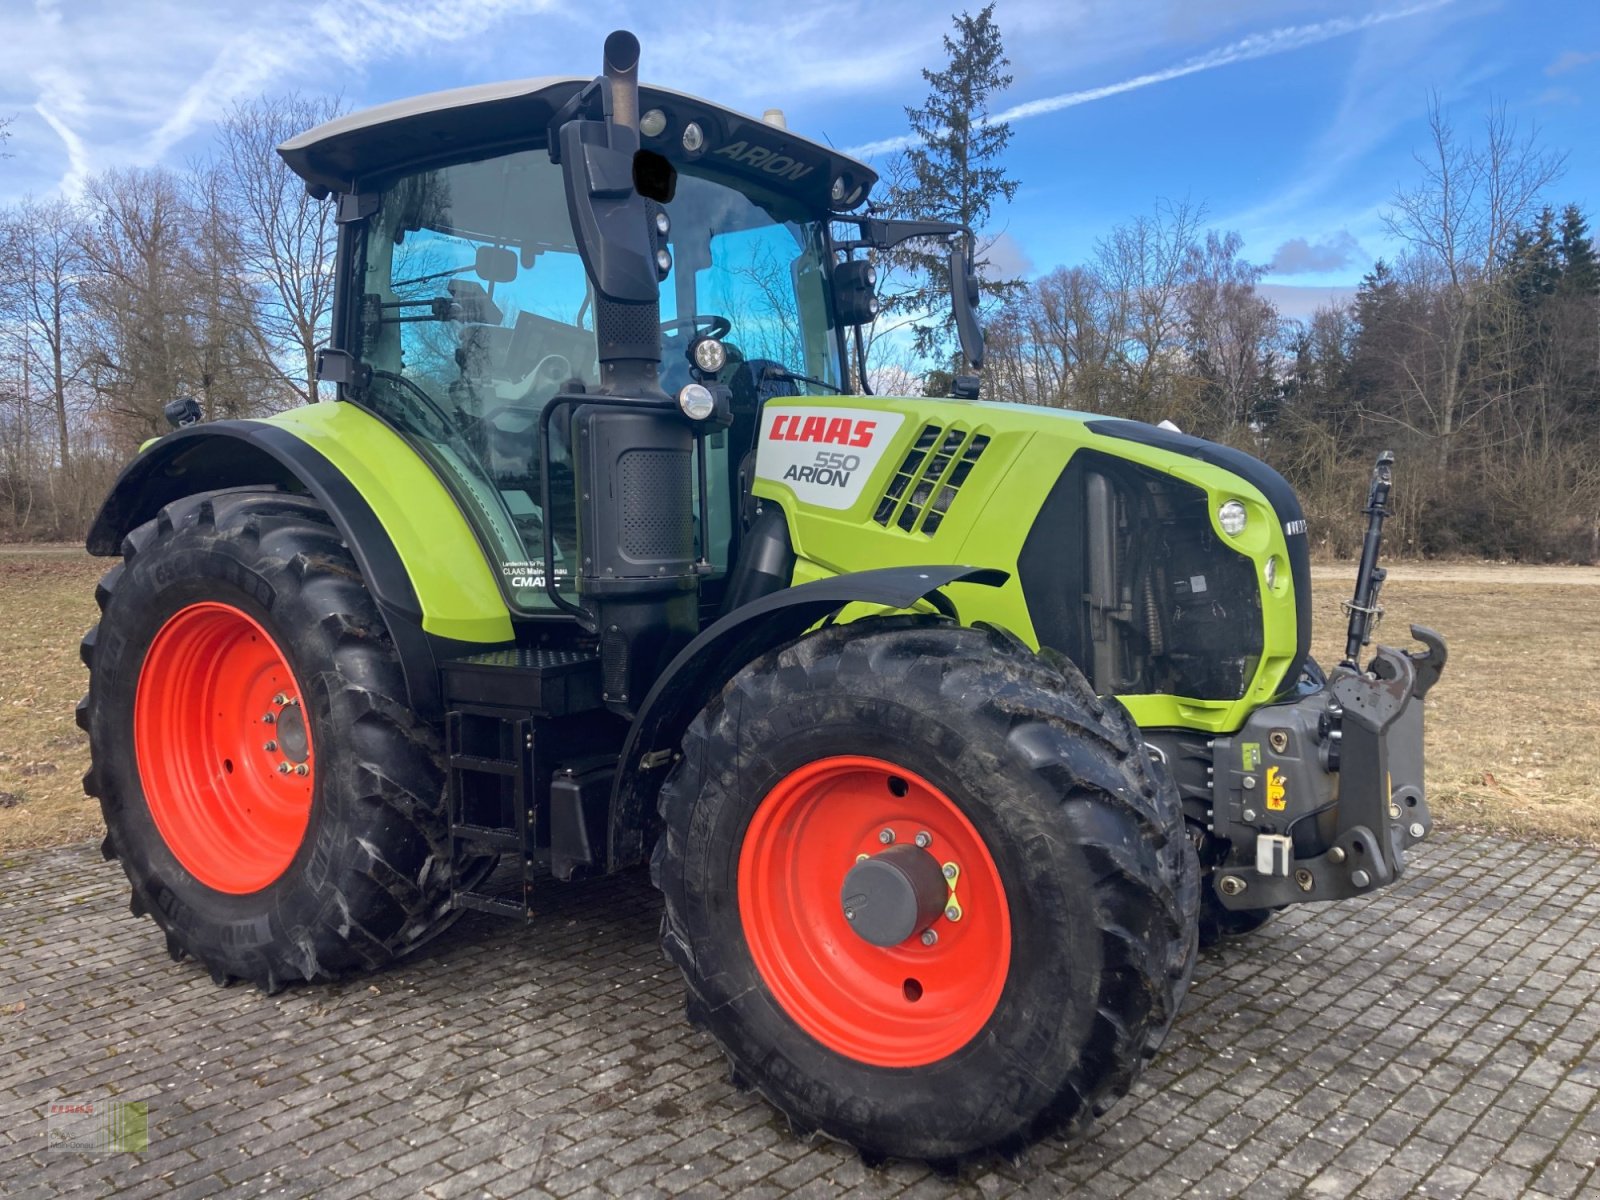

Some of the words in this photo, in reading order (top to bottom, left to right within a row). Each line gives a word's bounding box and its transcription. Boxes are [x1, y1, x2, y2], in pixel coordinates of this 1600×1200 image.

[712, 140, 814, 181] ARION
[769, 415, 877, 448] CLAAS
[813, 451, 861, 471] 550
[783, 464, 850, 487] ARION
[511, 576, 561, 587] CMATC
